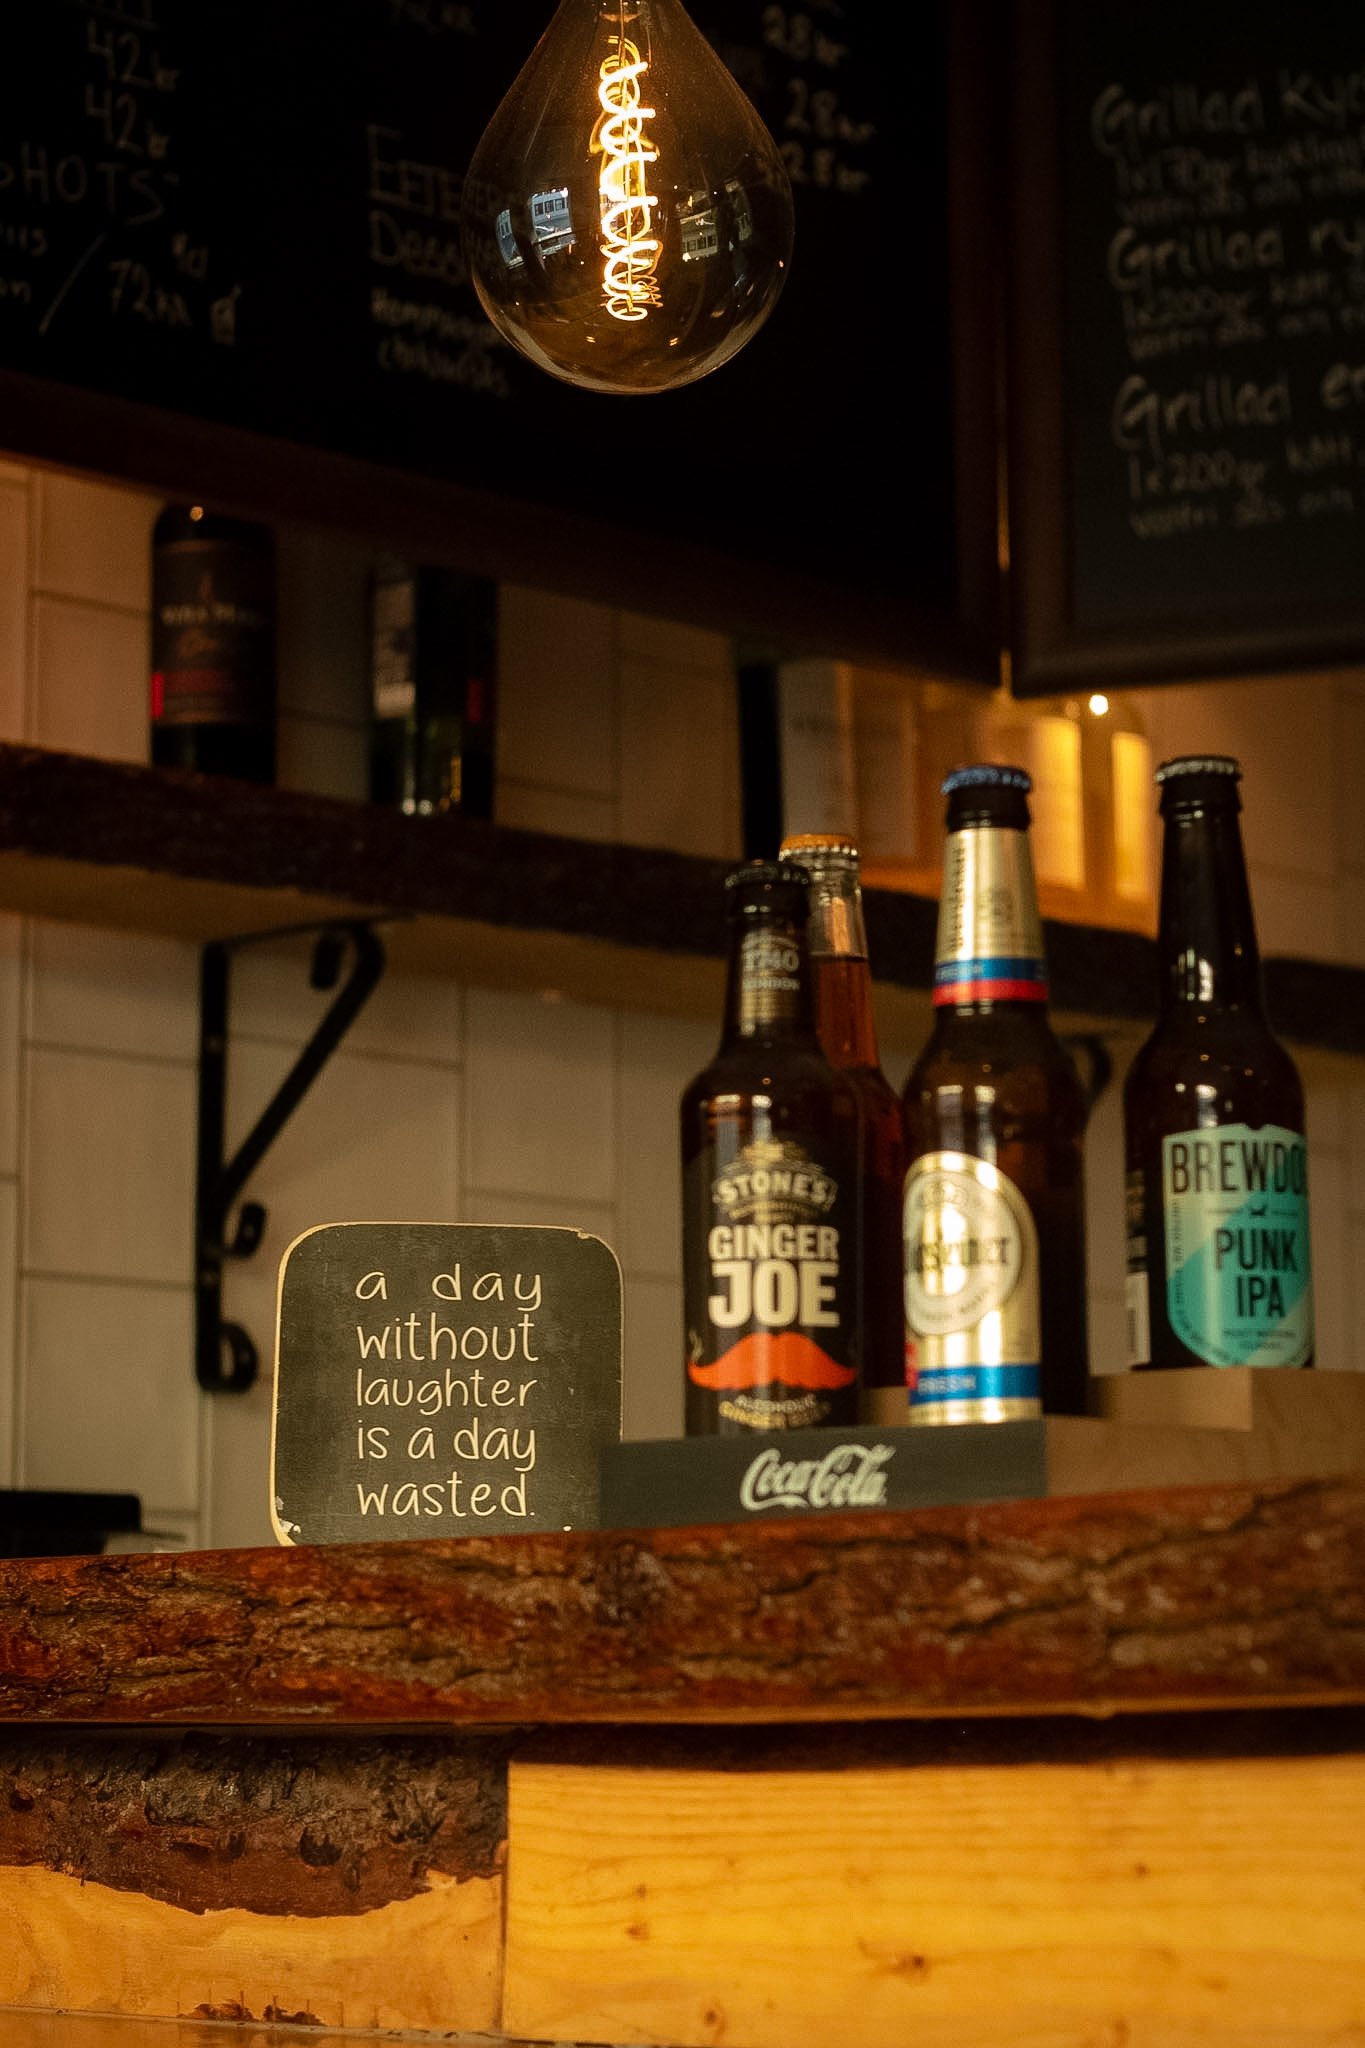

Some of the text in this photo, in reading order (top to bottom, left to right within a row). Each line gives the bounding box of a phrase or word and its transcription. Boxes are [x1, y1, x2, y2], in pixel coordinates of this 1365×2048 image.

[707, 1223, 841, 1260] GINGER
[1215, 1228, 1299, 1273] PUNK
[355, 1262, 543, 1312] a day
[707, 1258, 841, 1329] JOE
[1236, 1275, 1286, 1318] IPA
[356, 1312, 540, 1362] without
[356, 1368, 538, 1416] laughter
[357, 1416, 537, 1472] is a day
[356, 1470, 536, 1518] wasted.
